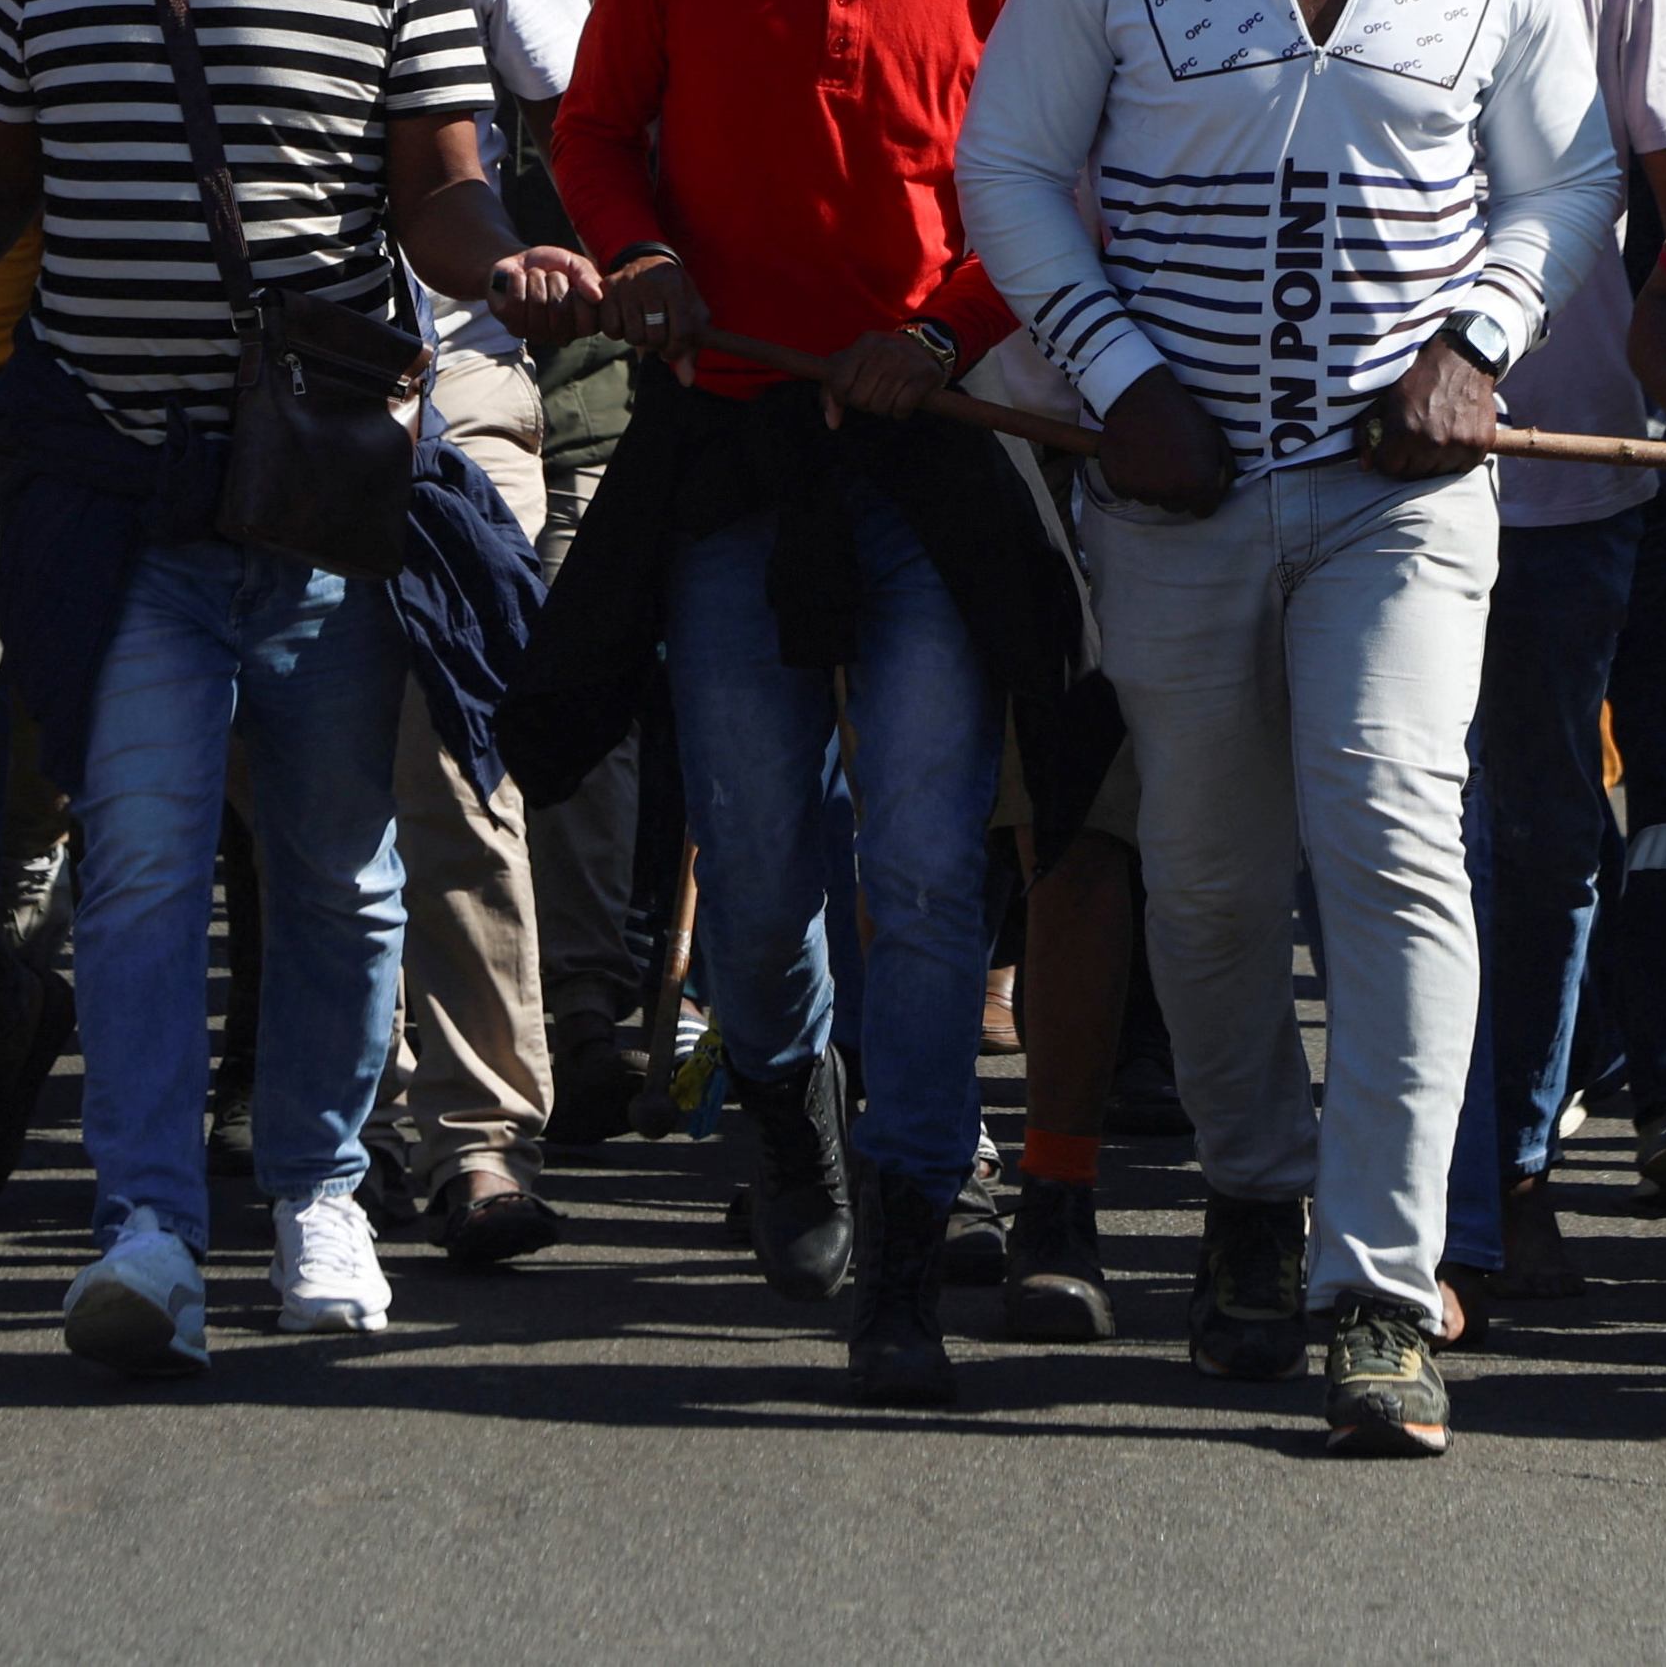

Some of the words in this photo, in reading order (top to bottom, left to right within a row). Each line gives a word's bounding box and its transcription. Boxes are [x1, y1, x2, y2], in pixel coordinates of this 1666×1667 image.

[1237, 12, 1264, 34] OPC
[1444, 7, 1469, 22] OPC
[1185, 18, 1212, 41] OPC
[1363, 21, 1393, 35] OPC
[1282, 35, 1308, 59] OPC
[1332, 44, 1364, 57] OPC
[1416, 33, 1444, 48] OPC
[1173, 56, 1198, 78] OPC
[1221, 47, 1249, 70] OPC
[1393, 59, 1423, 74] OPC
[1271, 157, 1329, 362] POINT
[1270, 376, 1318, 461] ON
